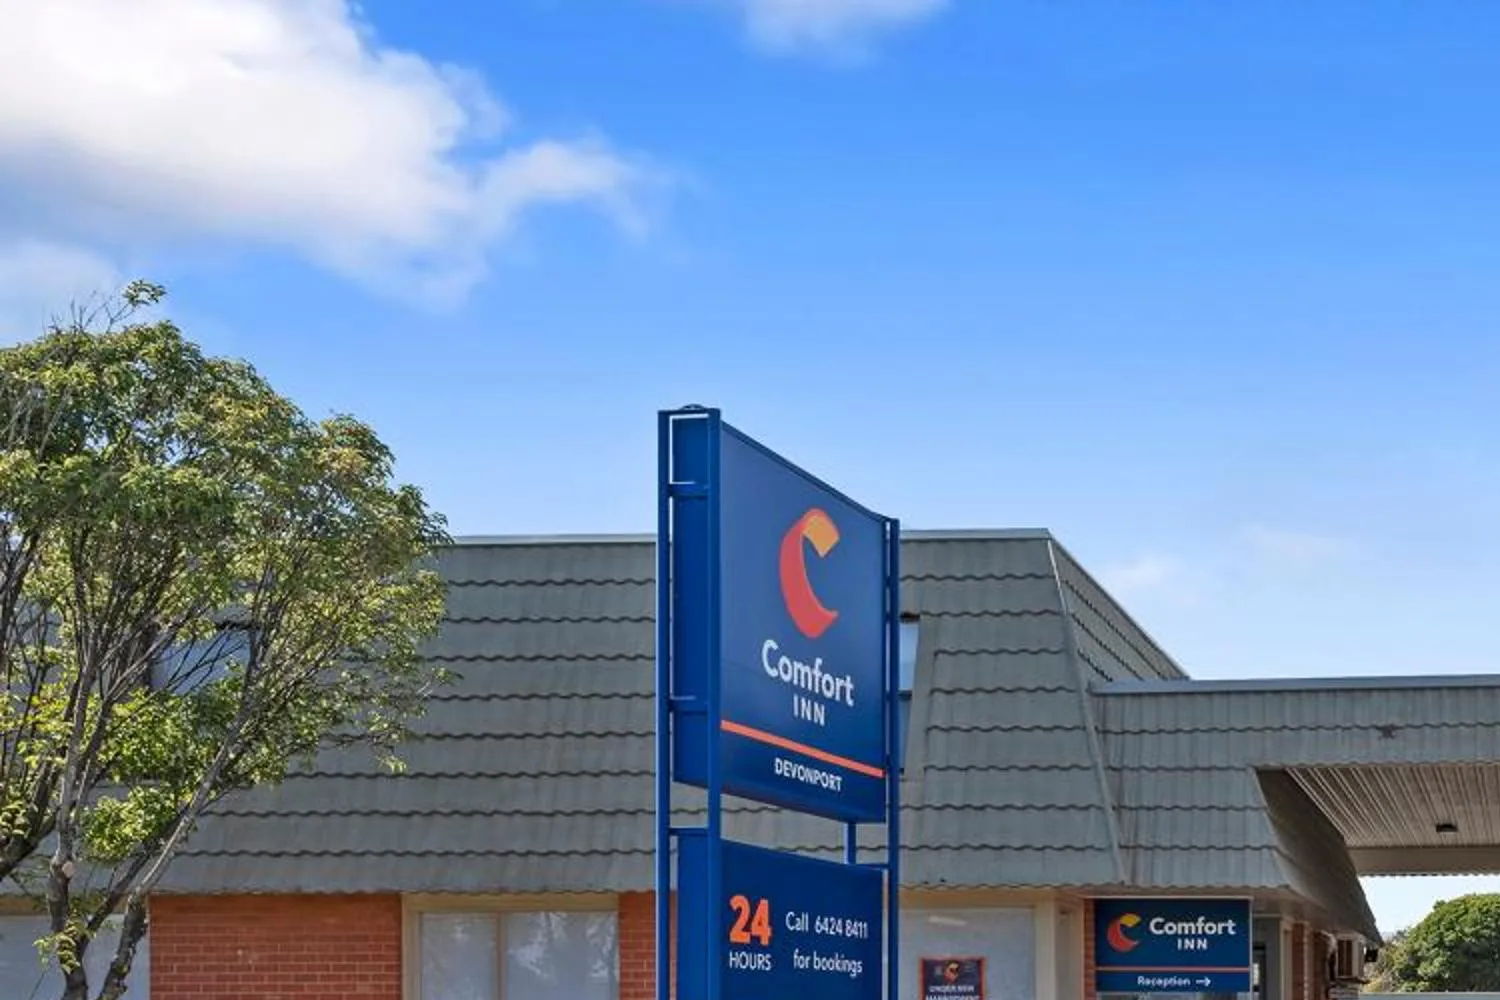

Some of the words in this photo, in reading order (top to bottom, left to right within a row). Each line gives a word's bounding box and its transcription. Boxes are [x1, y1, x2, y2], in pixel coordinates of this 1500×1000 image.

[761, 639, 854, 707] Comfort
[793, 693, 825, 726] INN
[774, 757, 842, 791] DEVONPORT
[729, 895, 772, 946] 24
[785, 911, 809, 932] Call
[814, 915, 842, 935] 6424
[845, 919, 868, 939] 8411
[1149, 916, 1236, 935] Comfort
[1177, 938, 1208, 950] INN
[729, 951, 772, 971] HOURS
[793, 948, 811, 969] for
[813, 950, 863, 979] bookings
[1137, 976, 1191, 988] Reception
